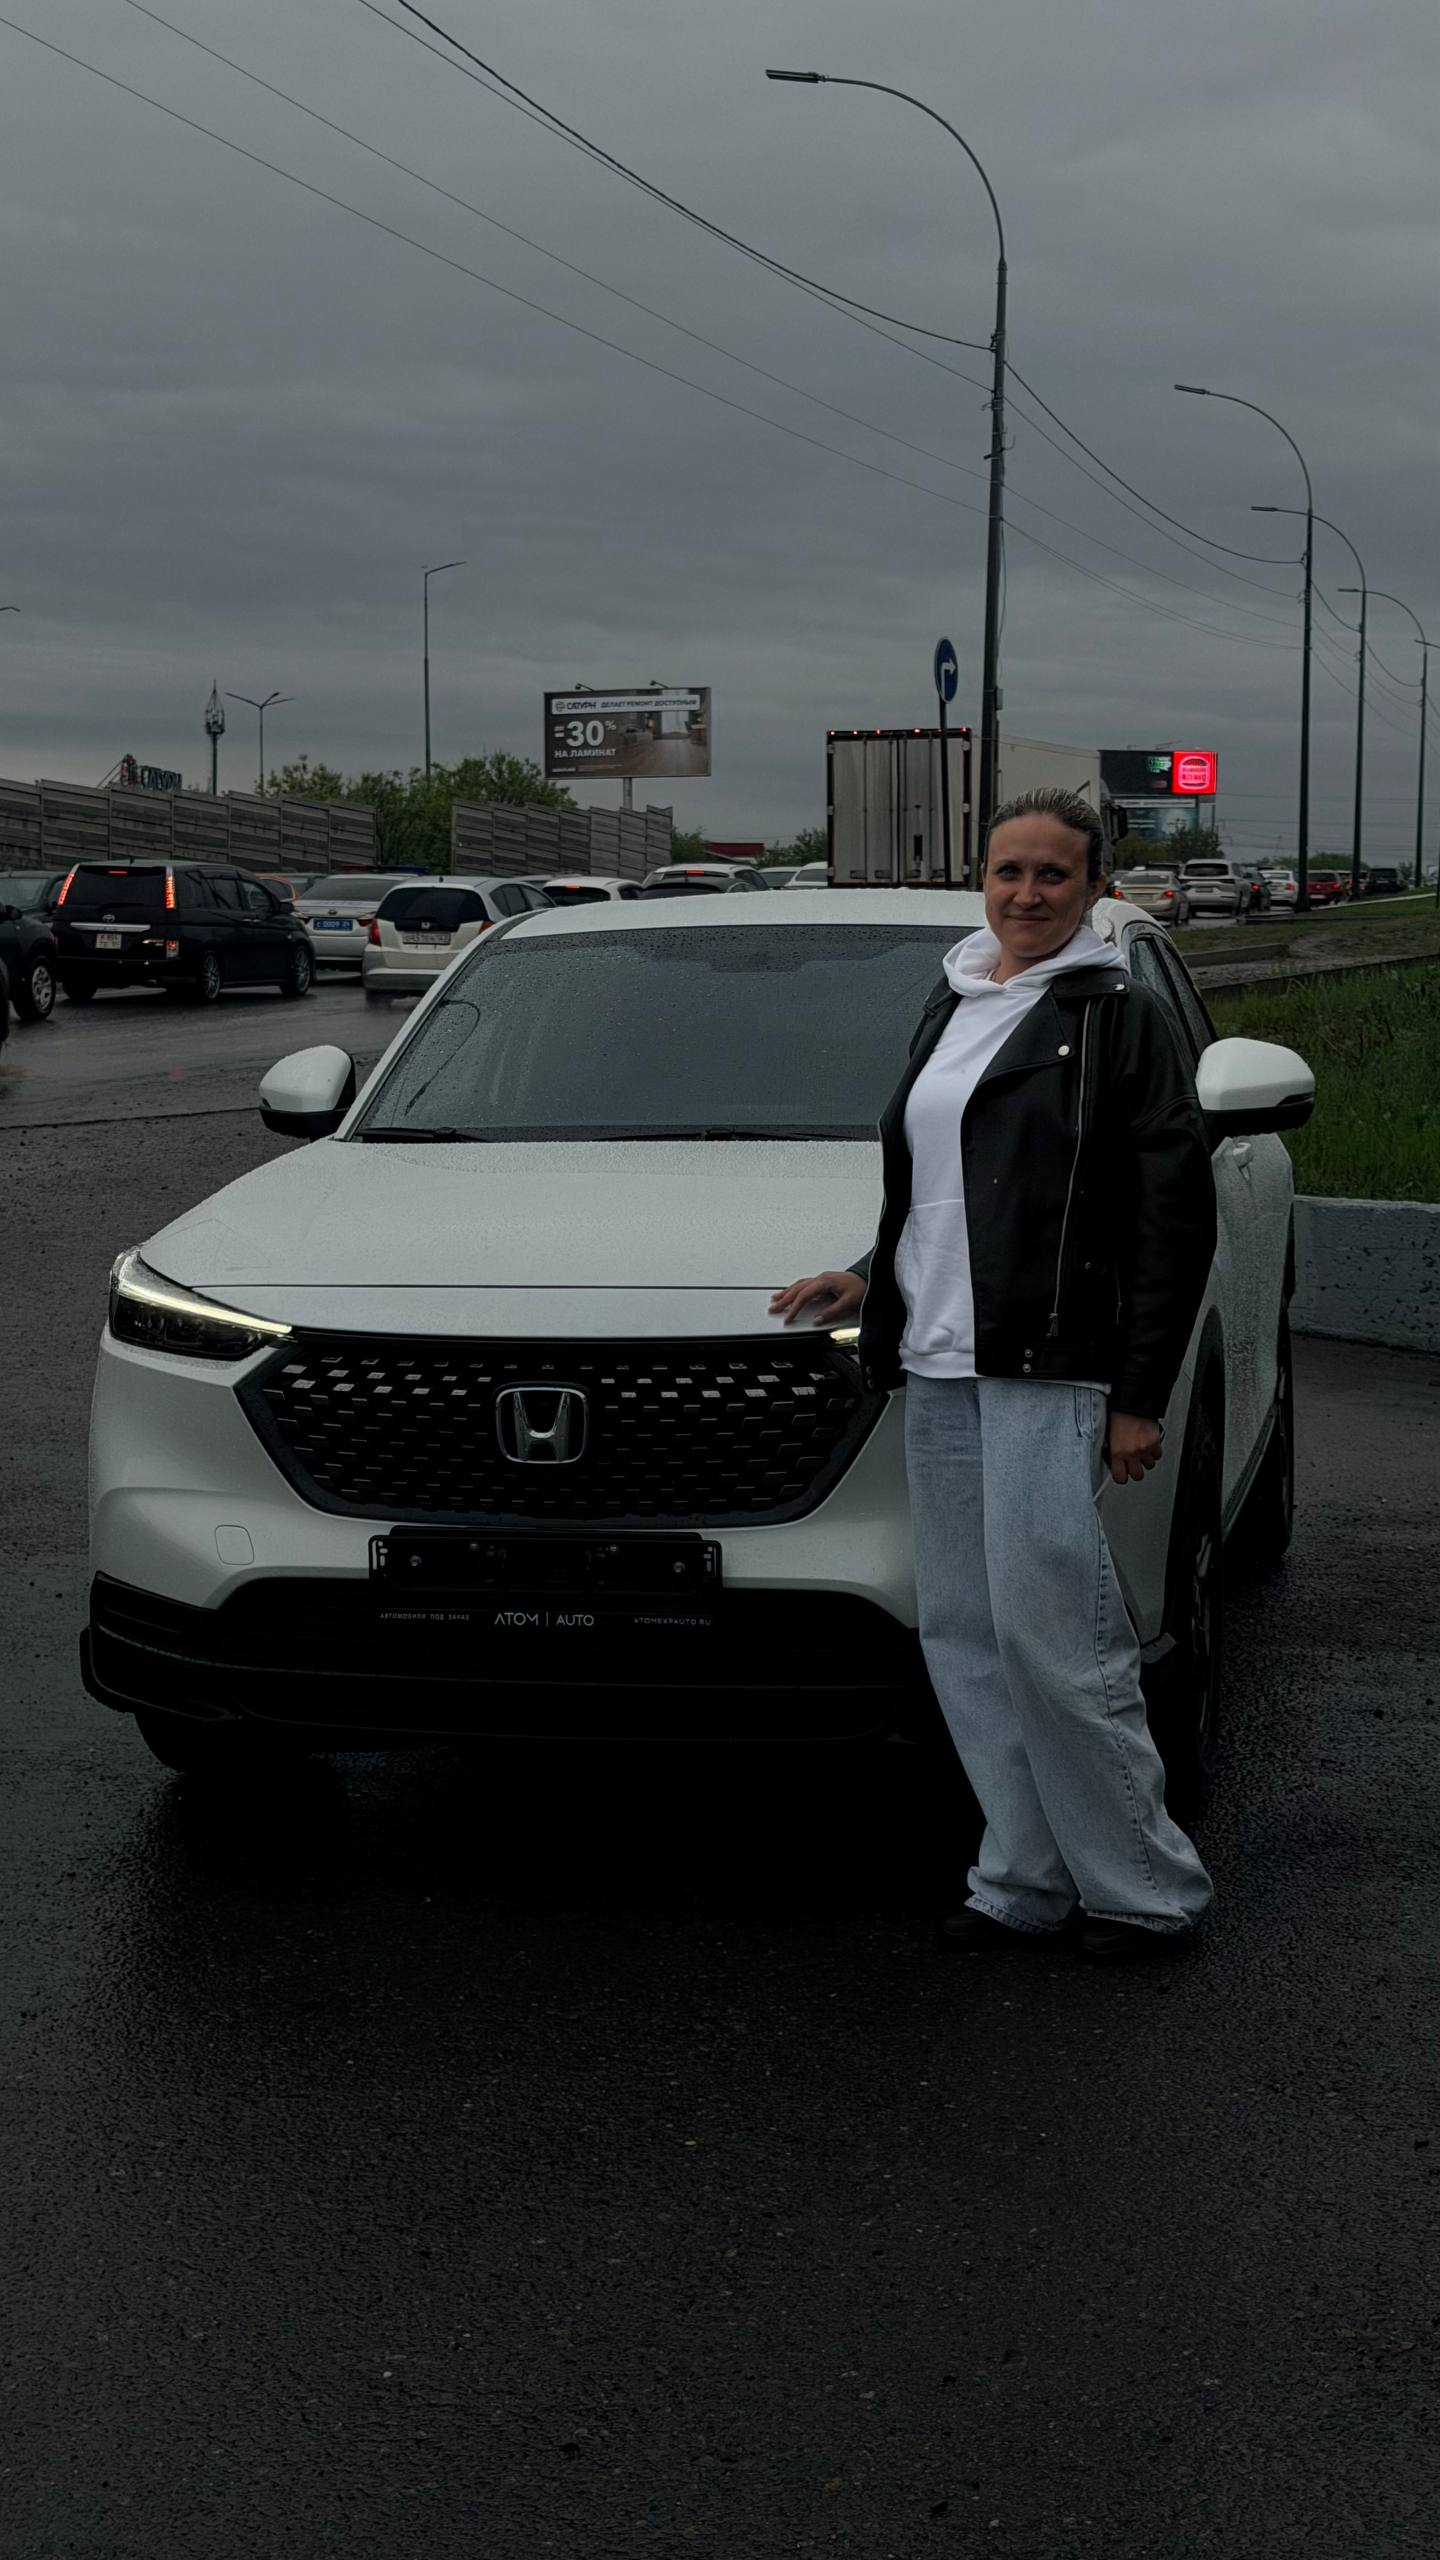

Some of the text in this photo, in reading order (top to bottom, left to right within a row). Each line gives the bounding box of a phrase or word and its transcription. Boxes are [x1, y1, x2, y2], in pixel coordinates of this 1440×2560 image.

[554, 748, 617, 758] НА ЛАМИНАТ
[430, 1613, 444, 1621] ПОД
[448, 1613, 470, 1622] ЗАКАЗ
[494, 1612, 595, 1626] ATOM AUTO
